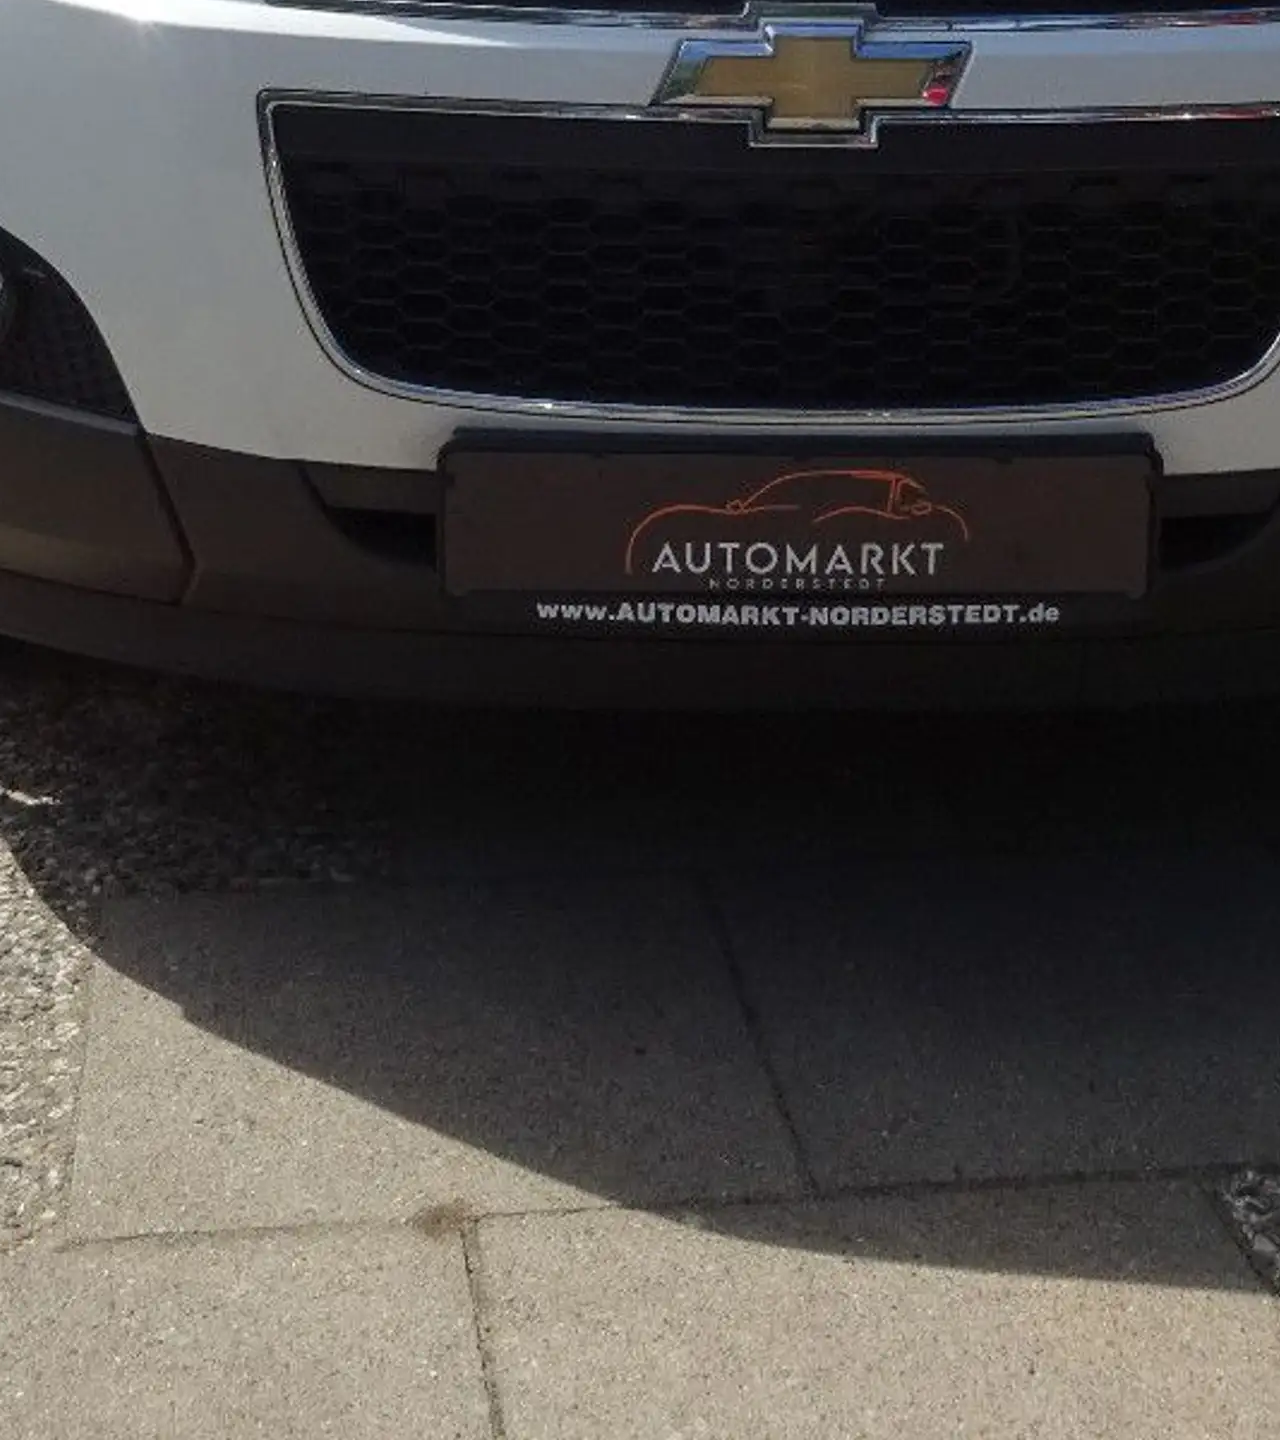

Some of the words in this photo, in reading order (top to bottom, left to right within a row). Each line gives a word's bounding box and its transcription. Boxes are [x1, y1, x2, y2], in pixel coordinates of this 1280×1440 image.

[652, 542, 944, 576] AUTOMARKT
[709, 578, 885, 590] NORDERSTEDT
[536, 601, 1060, 627] www.AUTOMARKT-NORDERSTEDT.de
